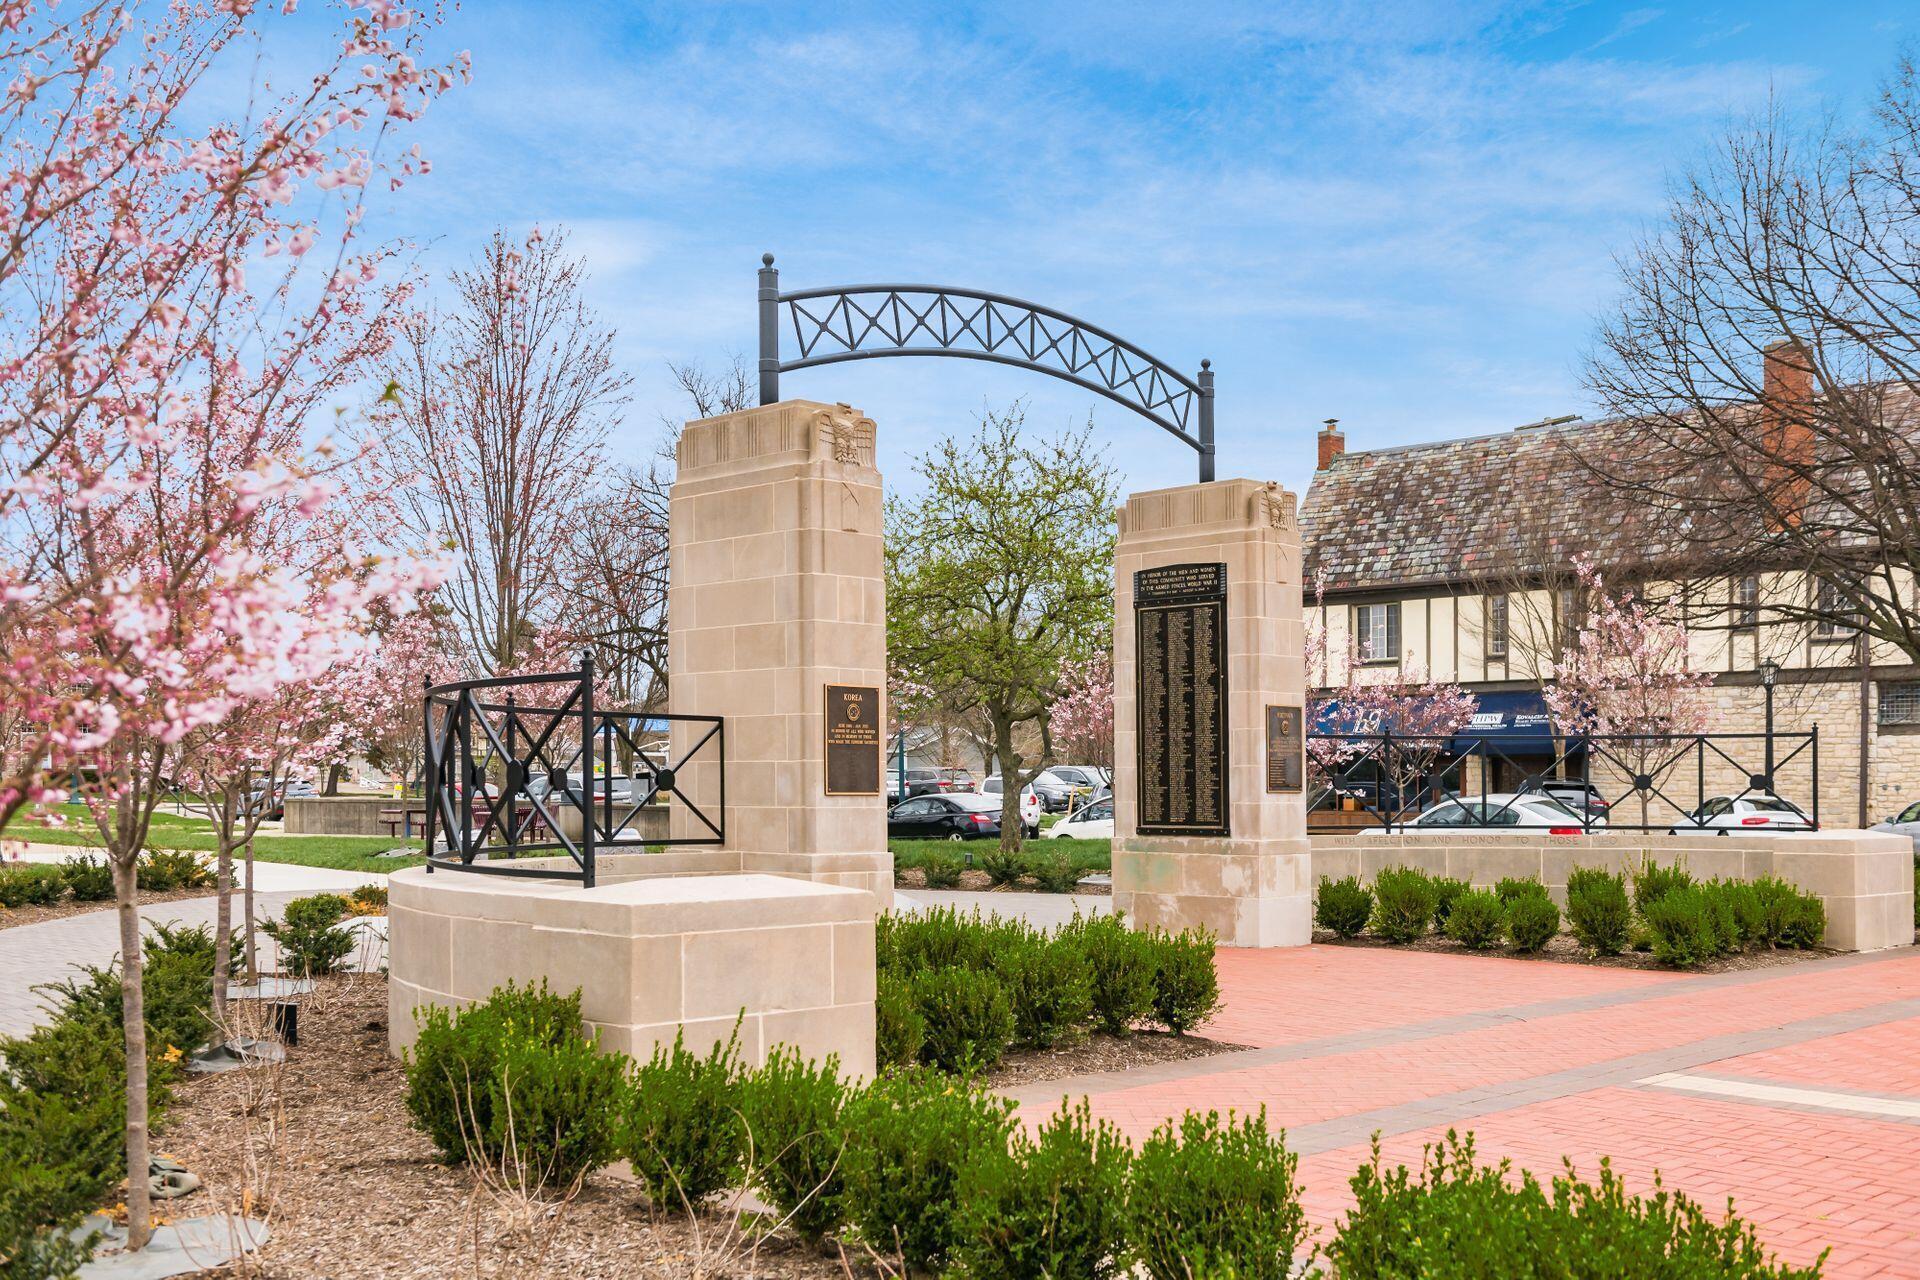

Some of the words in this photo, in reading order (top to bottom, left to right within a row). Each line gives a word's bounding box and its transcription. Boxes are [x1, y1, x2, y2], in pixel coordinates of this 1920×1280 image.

[844, 693, 863, 701] KOREA
[1368, 837, 1420, 845] AFFECTION
[1432, 836, 1451, 844] AND
[1462, 836, 1502, 845] HONOR
[1515, 836, 1529, 844] TO
[1543, 836, 1580, 845] THOSE
[1592, 836, 1618, 845] WHO
